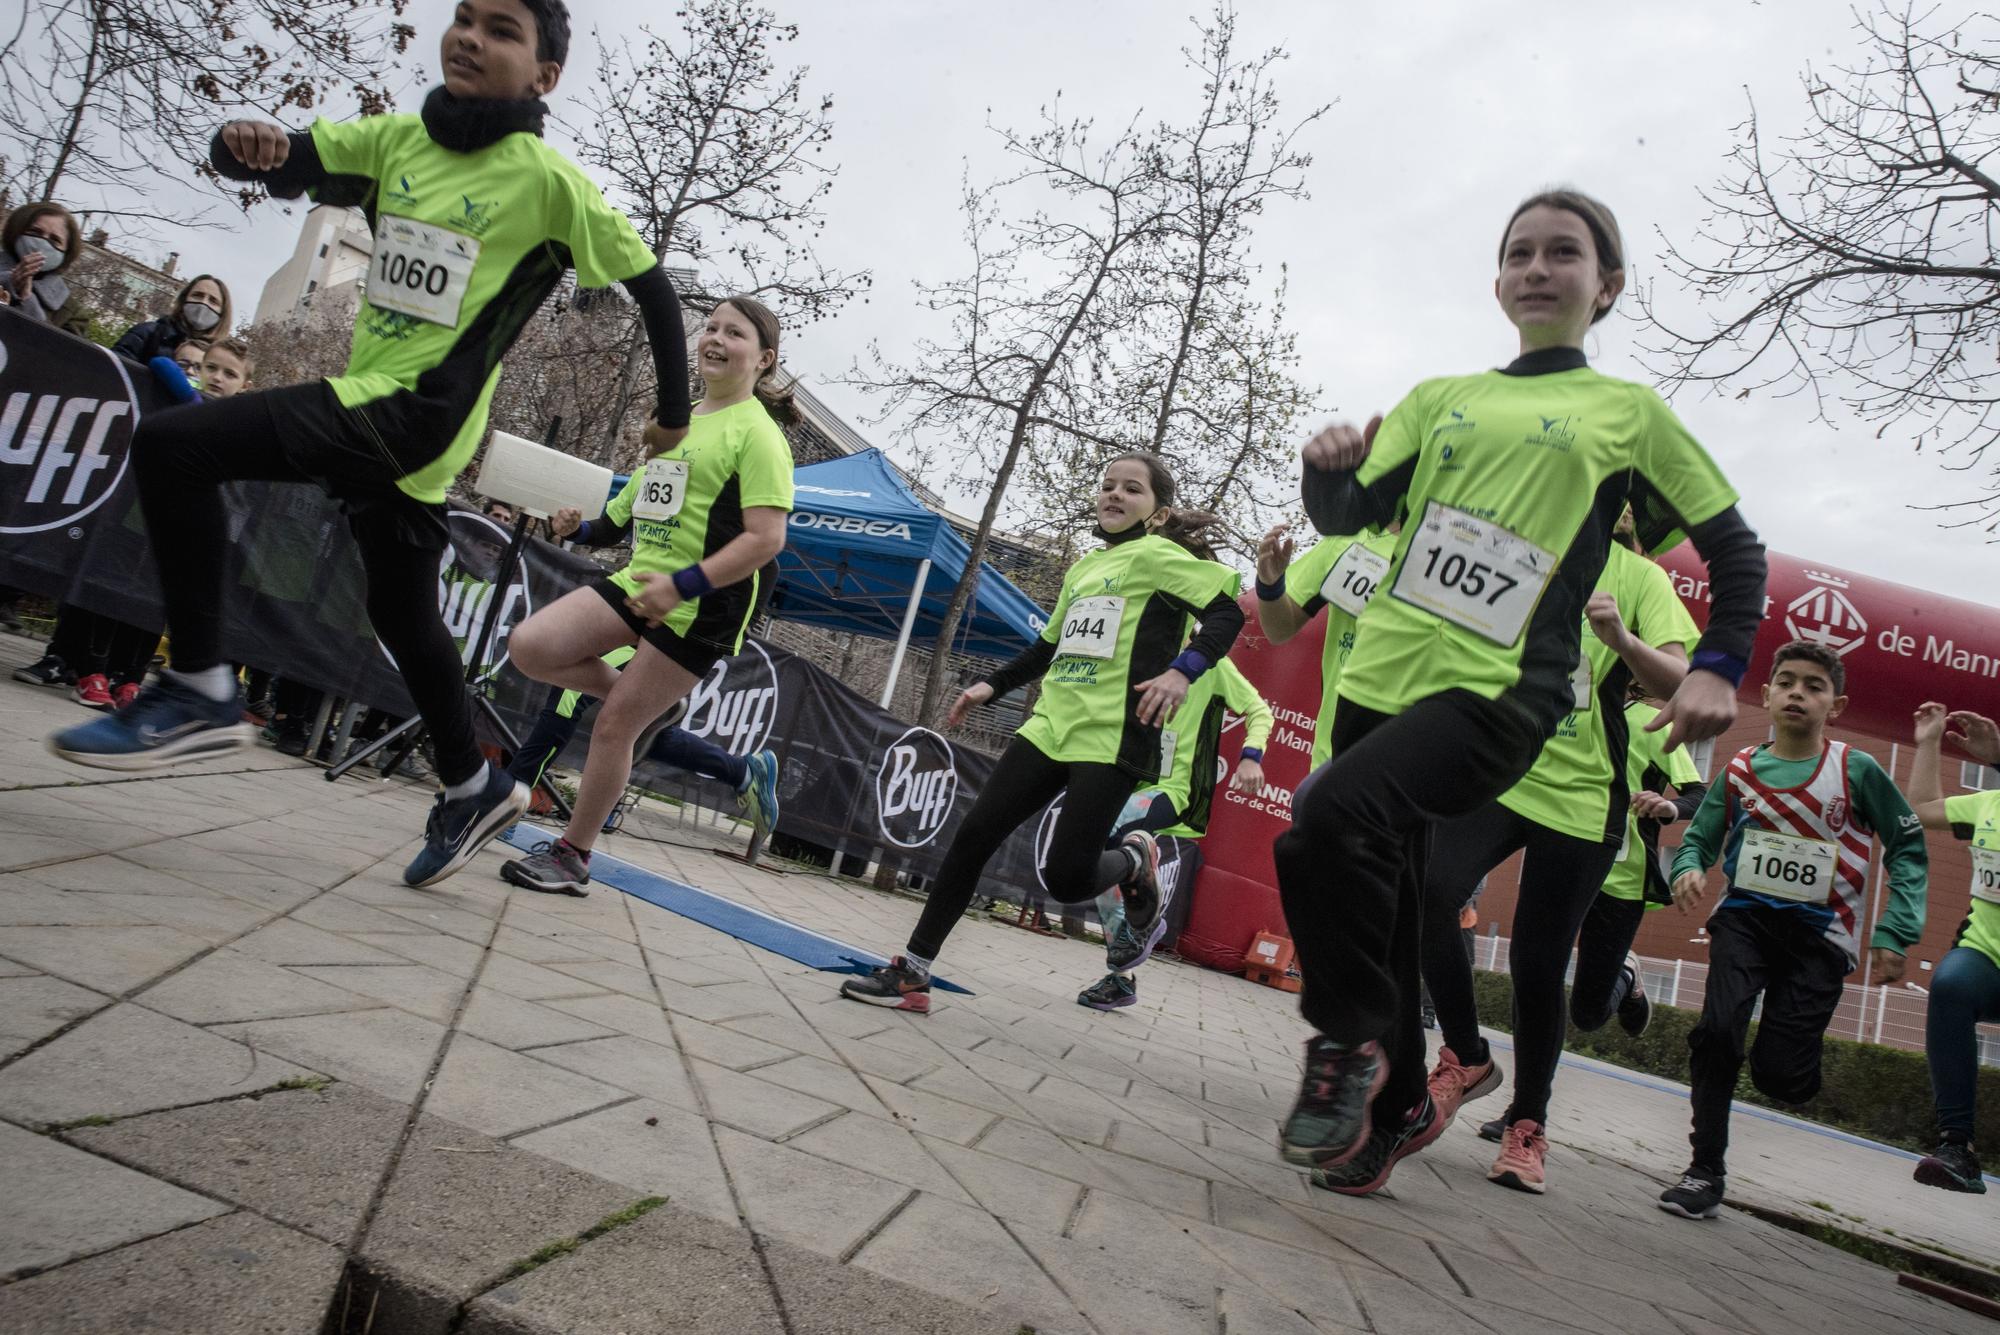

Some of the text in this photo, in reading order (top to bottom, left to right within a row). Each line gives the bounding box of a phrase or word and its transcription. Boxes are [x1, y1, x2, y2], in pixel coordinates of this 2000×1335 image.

[379, 250, 450, 296] 1060
[0, 391, 131, 504] uff
[641, 481, 673, 505] 63
[788, 511, 912, 540] ORBEA
[1423, 545, 1519, 606] 1057
[1877, 625, 1916, 656] de
[1225, 790, 1248, 804] Cor
[1248, 798, 1265, 811] de
[1752, 854, 1818, 886] 1068
